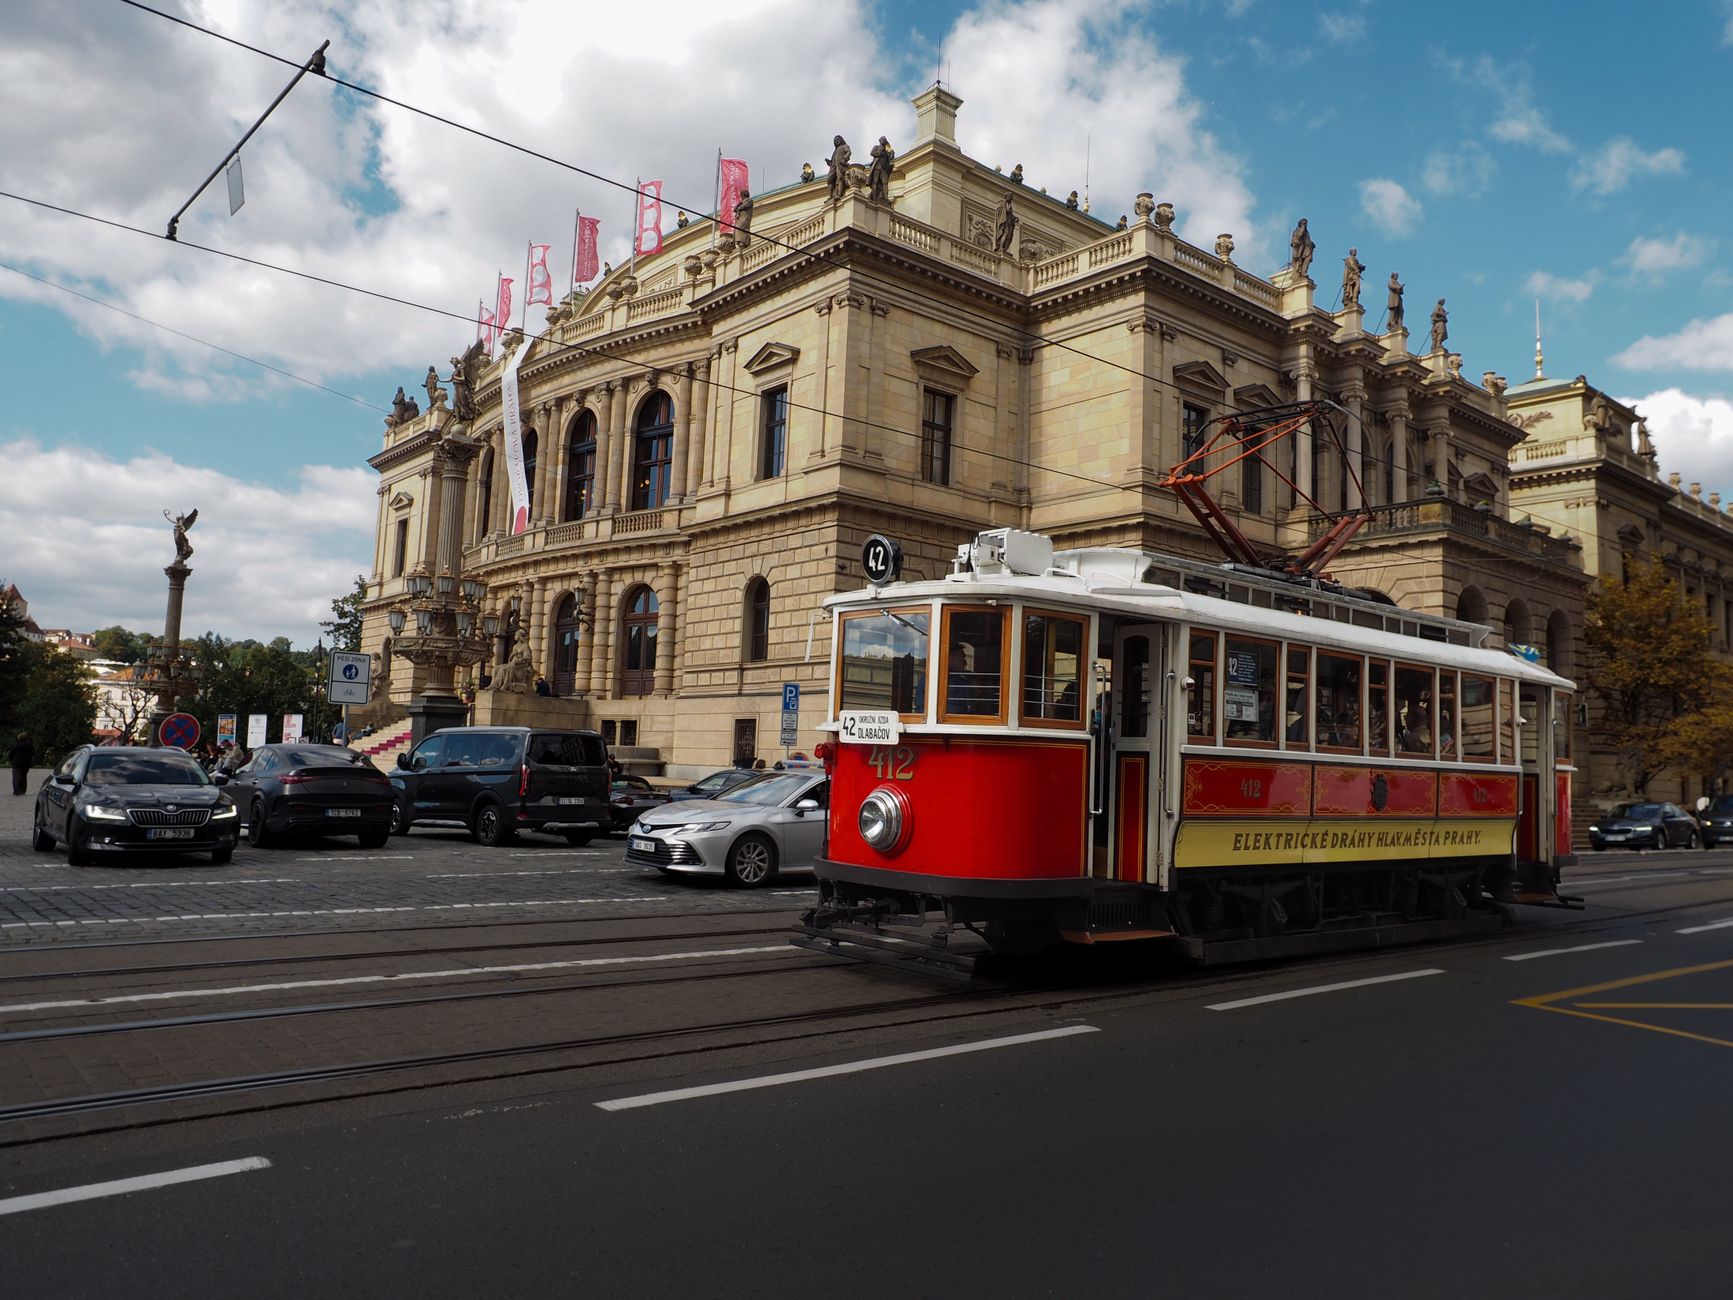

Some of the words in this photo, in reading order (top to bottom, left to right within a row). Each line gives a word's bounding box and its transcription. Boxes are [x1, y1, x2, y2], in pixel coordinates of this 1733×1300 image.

[869, 546, 885, 571] 42
[786, 686, 796, 703] P
[843, 716, 856, 736] 42
[858, 726, 890, 740] DLABAČOV
[868, 745, 914, 780] 412
[1241, 778, 1261, 798] 412
[1232, 829, 1329, 851] ELEKTRICKÉ
[1331, 829, 1375, 849] DRÁHY
[1402, 828, 1440, 847] MĚSTA
[1443, 829, 1481, 846] PRAHY.
